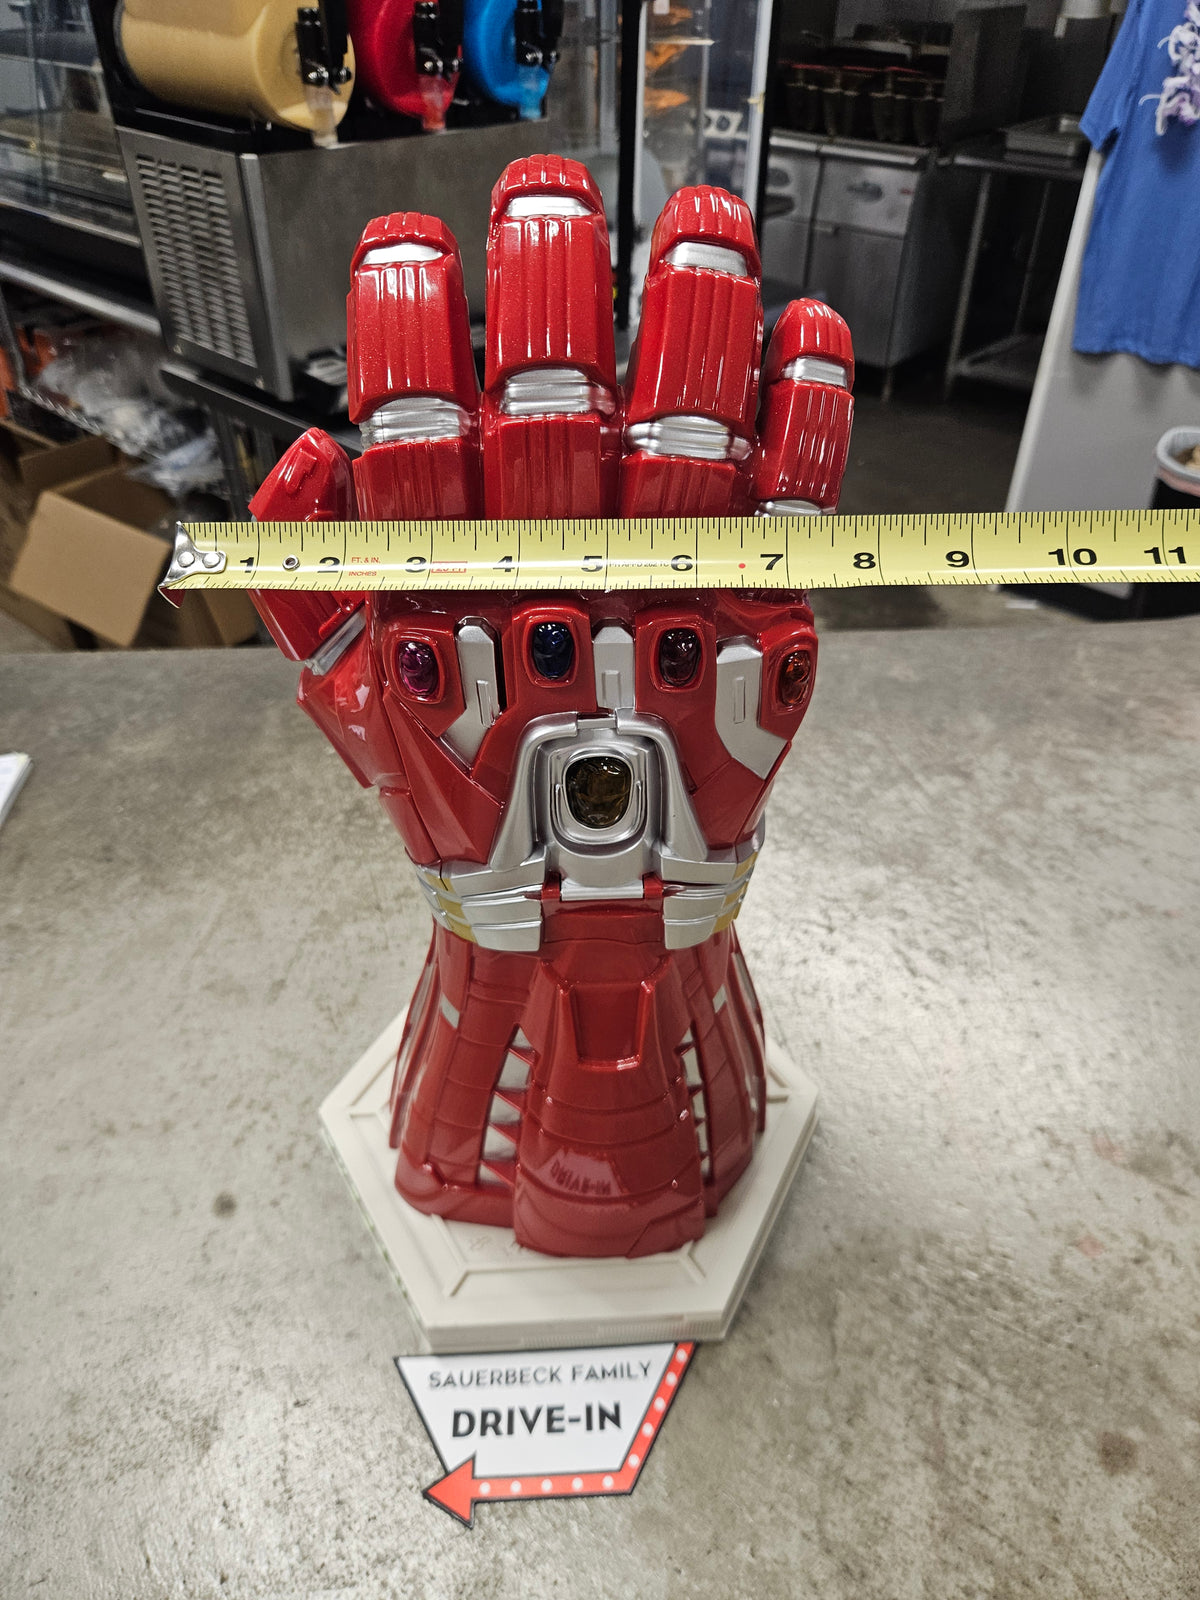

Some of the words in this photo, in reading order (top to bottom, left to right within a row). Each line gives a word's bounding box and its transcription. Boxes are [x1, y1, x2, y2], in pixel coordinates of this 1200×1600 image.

[239, 556, 255, 573] 1
[317, 556, 340, 573] 2
[405, 556, 427, 573] 3
[492, 555, 514, 573] 4
[581, 555, 604, 573] 5
[670, 554, 694, 572] 6
[760, 553, 784, 571] 7
[853, 552, 876, 569] 8
[945, 551, 970, 568] 9
[1048, 548, 1097, 566] 10
[1144, 546, 1187, 565] 11
[428, 1365, 562, 1388] SAUERBECK
[571, 1361, 651, 1381] FAMILY
[452, 1402, 622, 1437] DRIVE-IN
